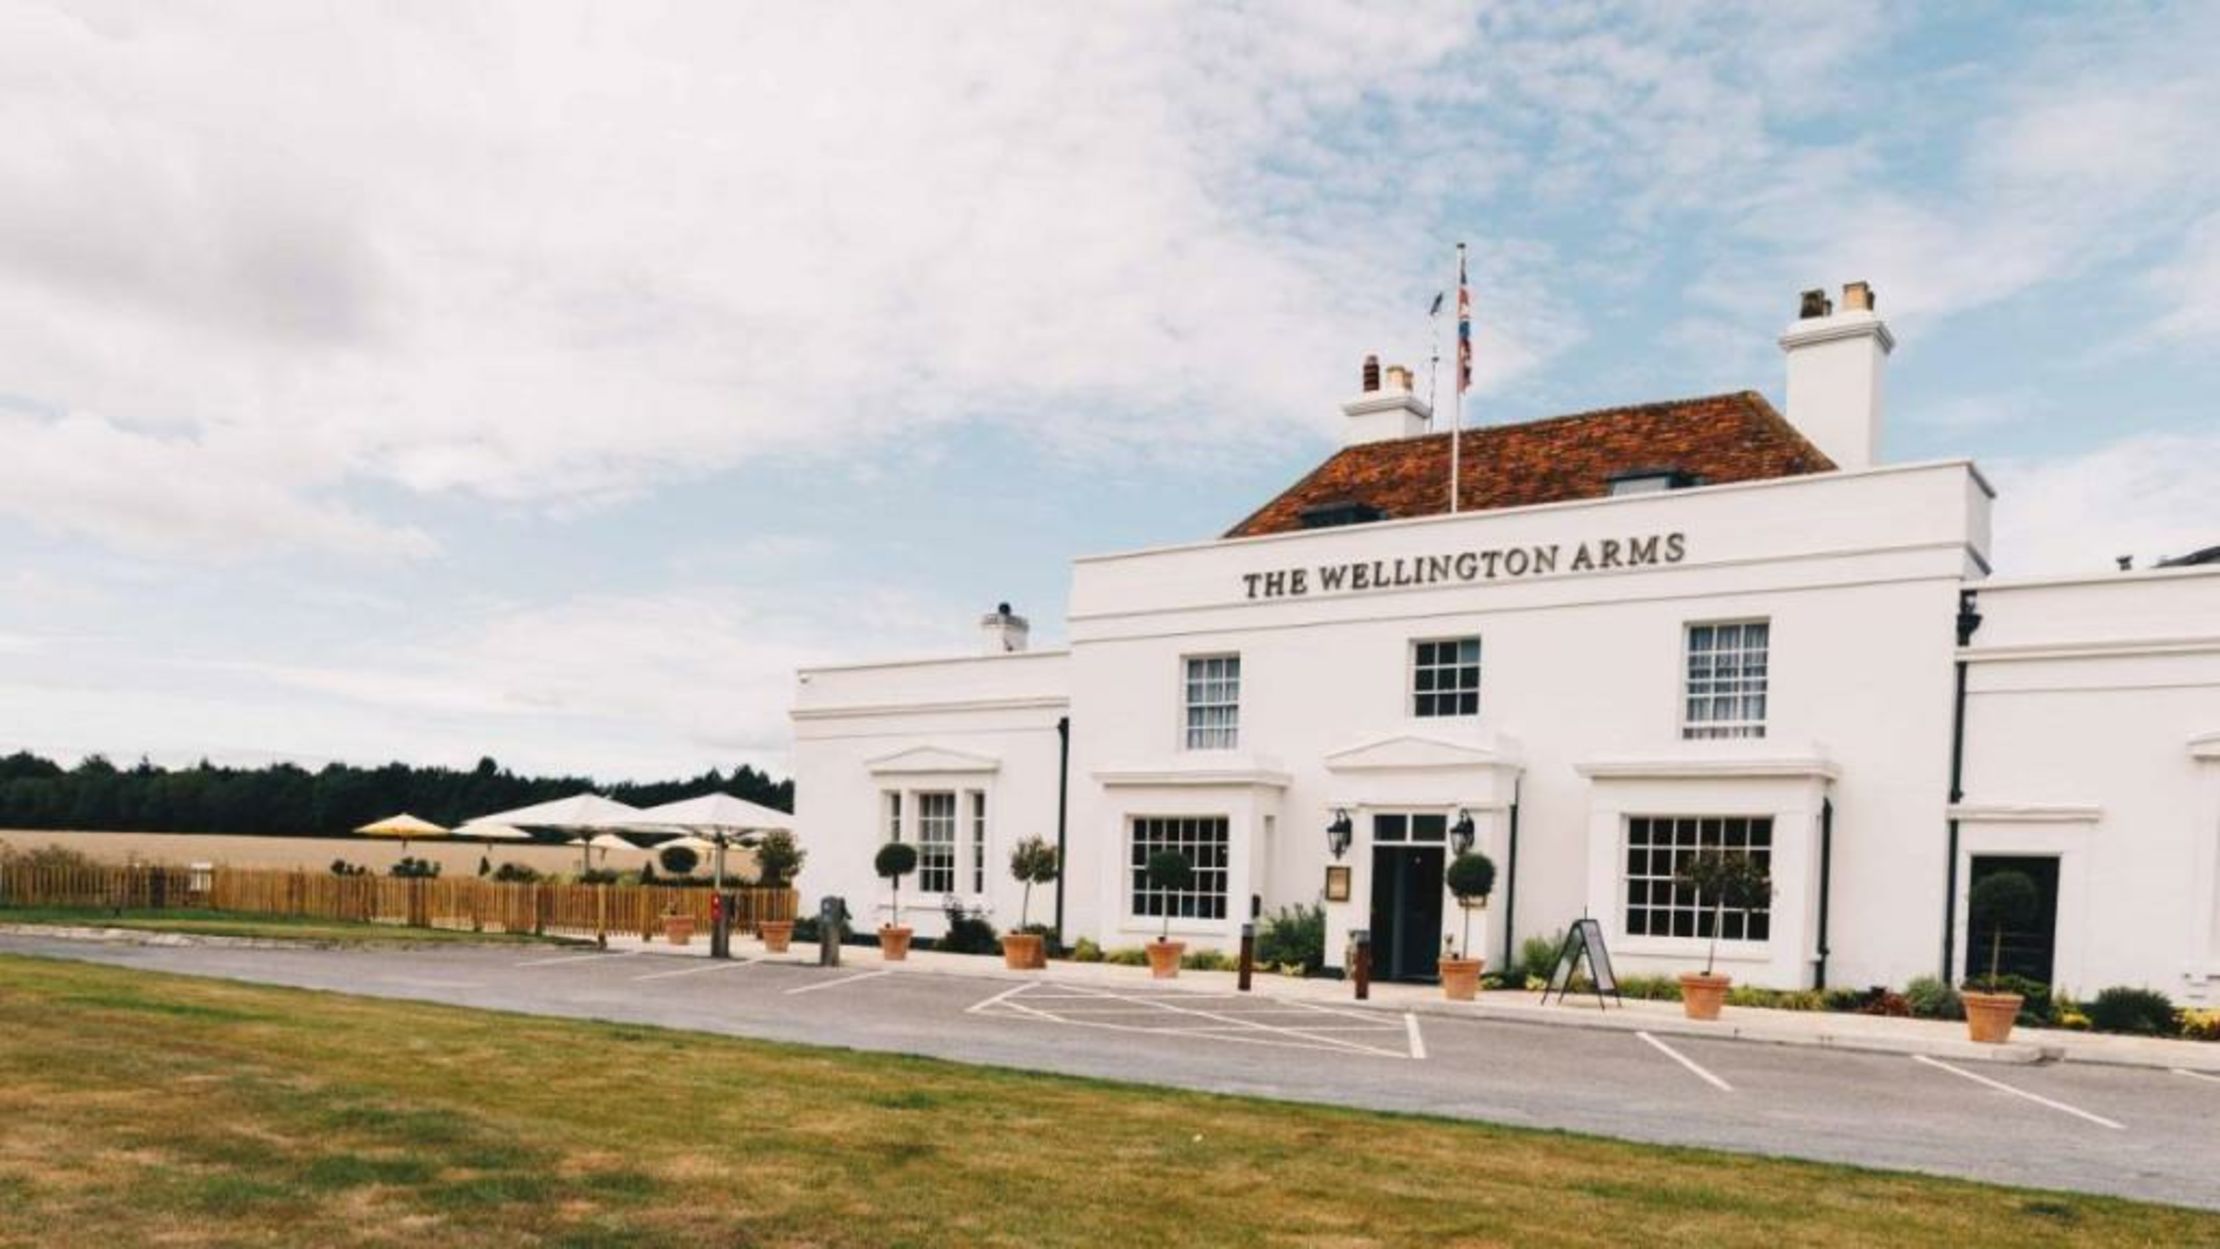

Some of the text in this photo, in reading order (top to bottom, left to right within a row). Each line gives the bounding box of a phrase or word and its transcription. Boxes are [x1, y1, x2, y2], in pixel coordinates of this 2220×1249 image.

[1243, 532, 1687, 599] THE WELLINGTON ARMS
